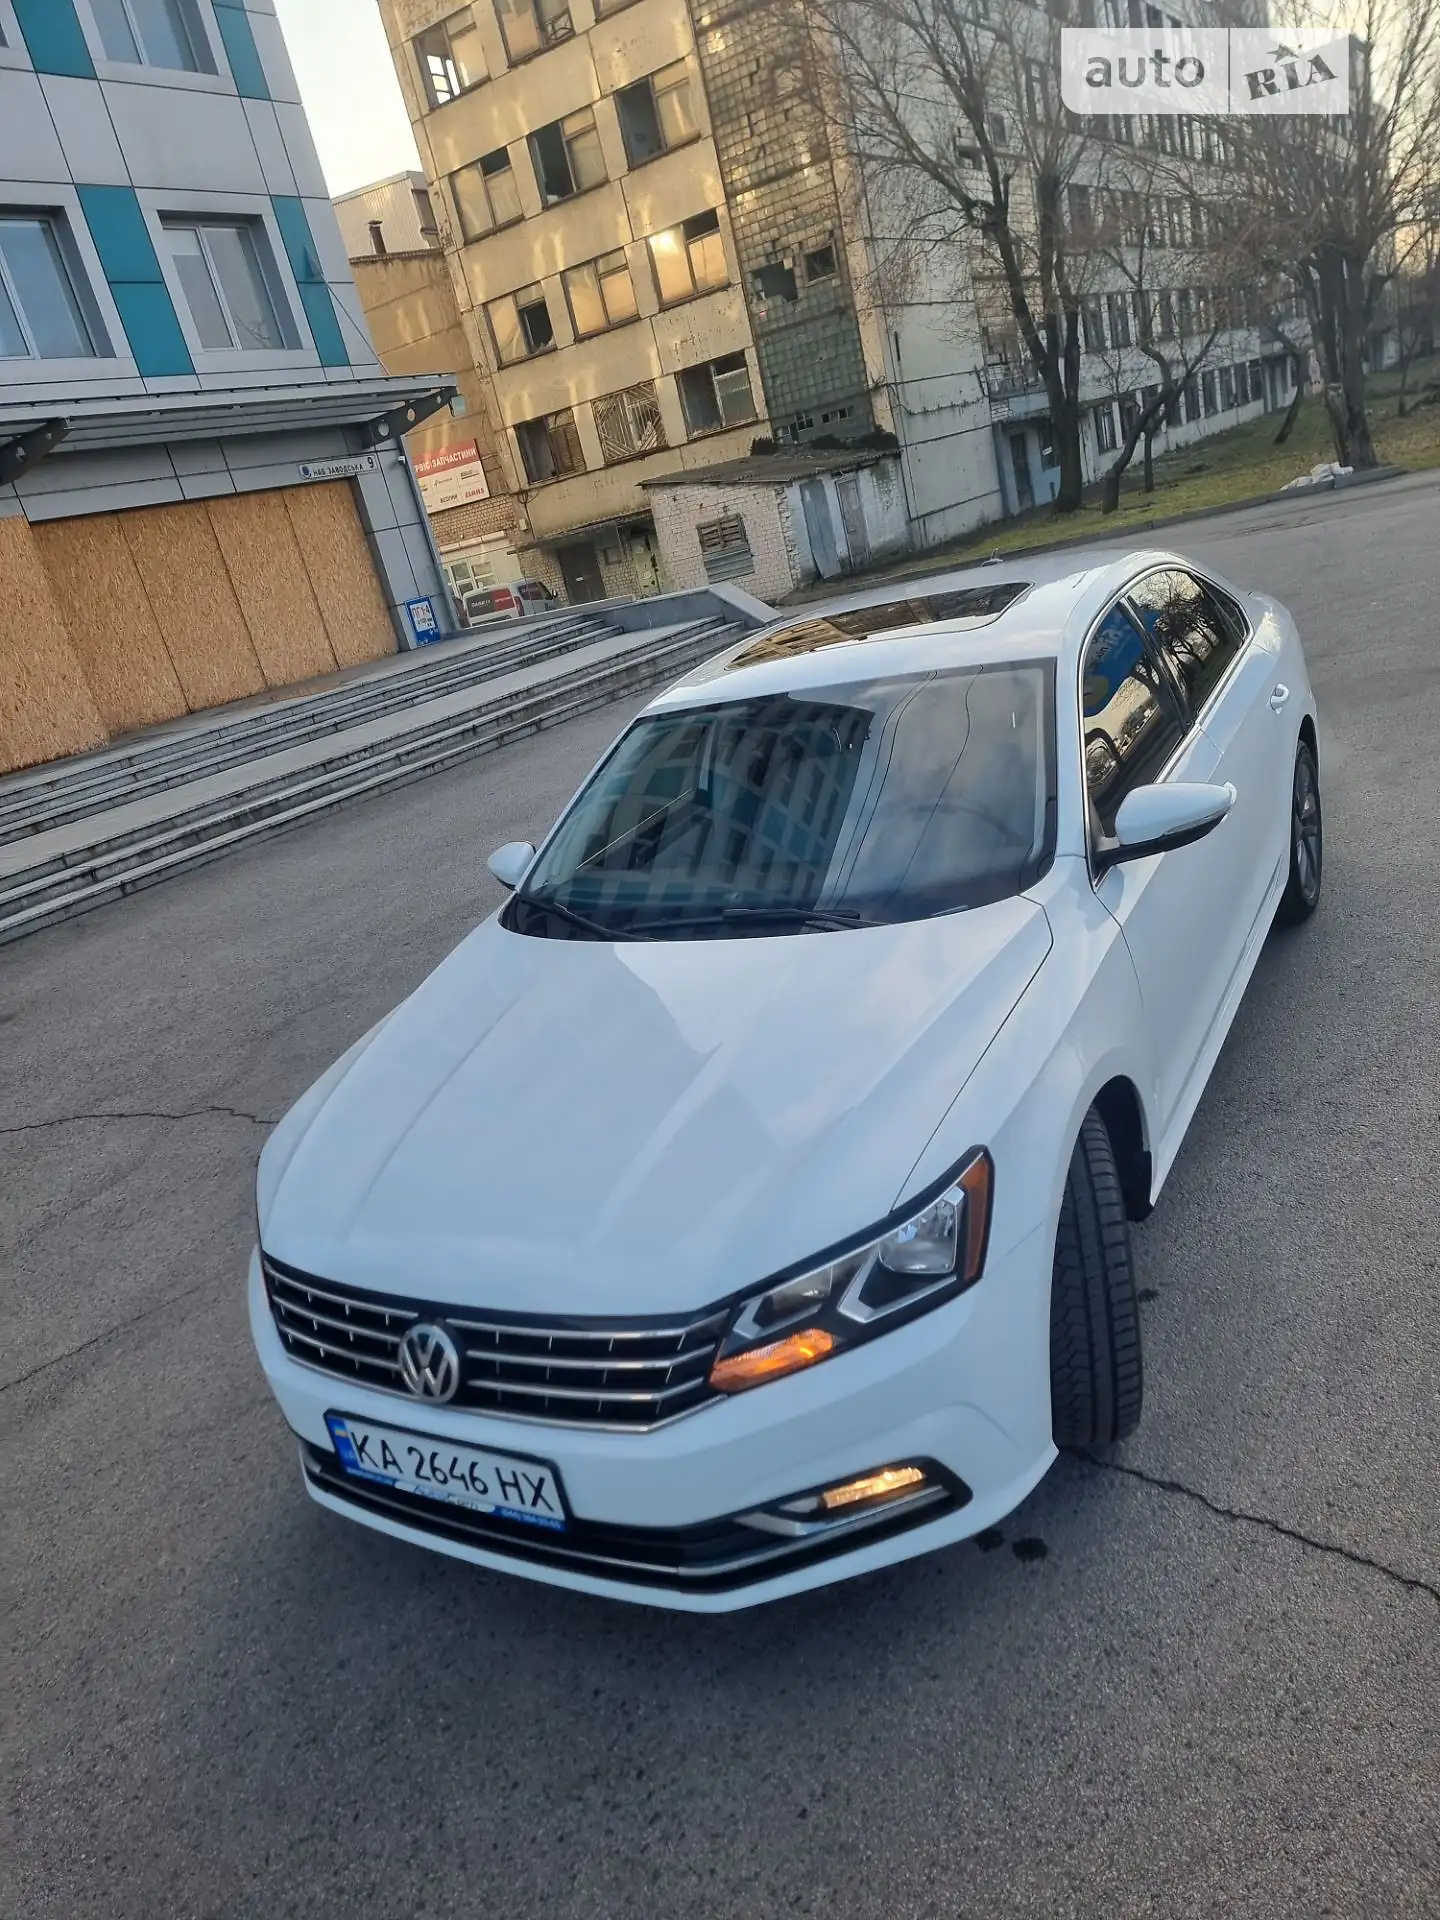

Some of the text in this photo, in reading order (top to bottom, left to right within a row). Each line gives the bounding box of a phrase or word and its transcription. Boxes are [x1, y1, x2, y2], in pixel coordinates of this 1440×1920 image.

[328, 463, 363, 475] ЗАВОДСЬКА
[367, 456, 374, 469] 9
[431, 447, 477, 468] ЗАПЧАСТИНИ
[350, 1431, 555, 1512] KA 2646 HX
